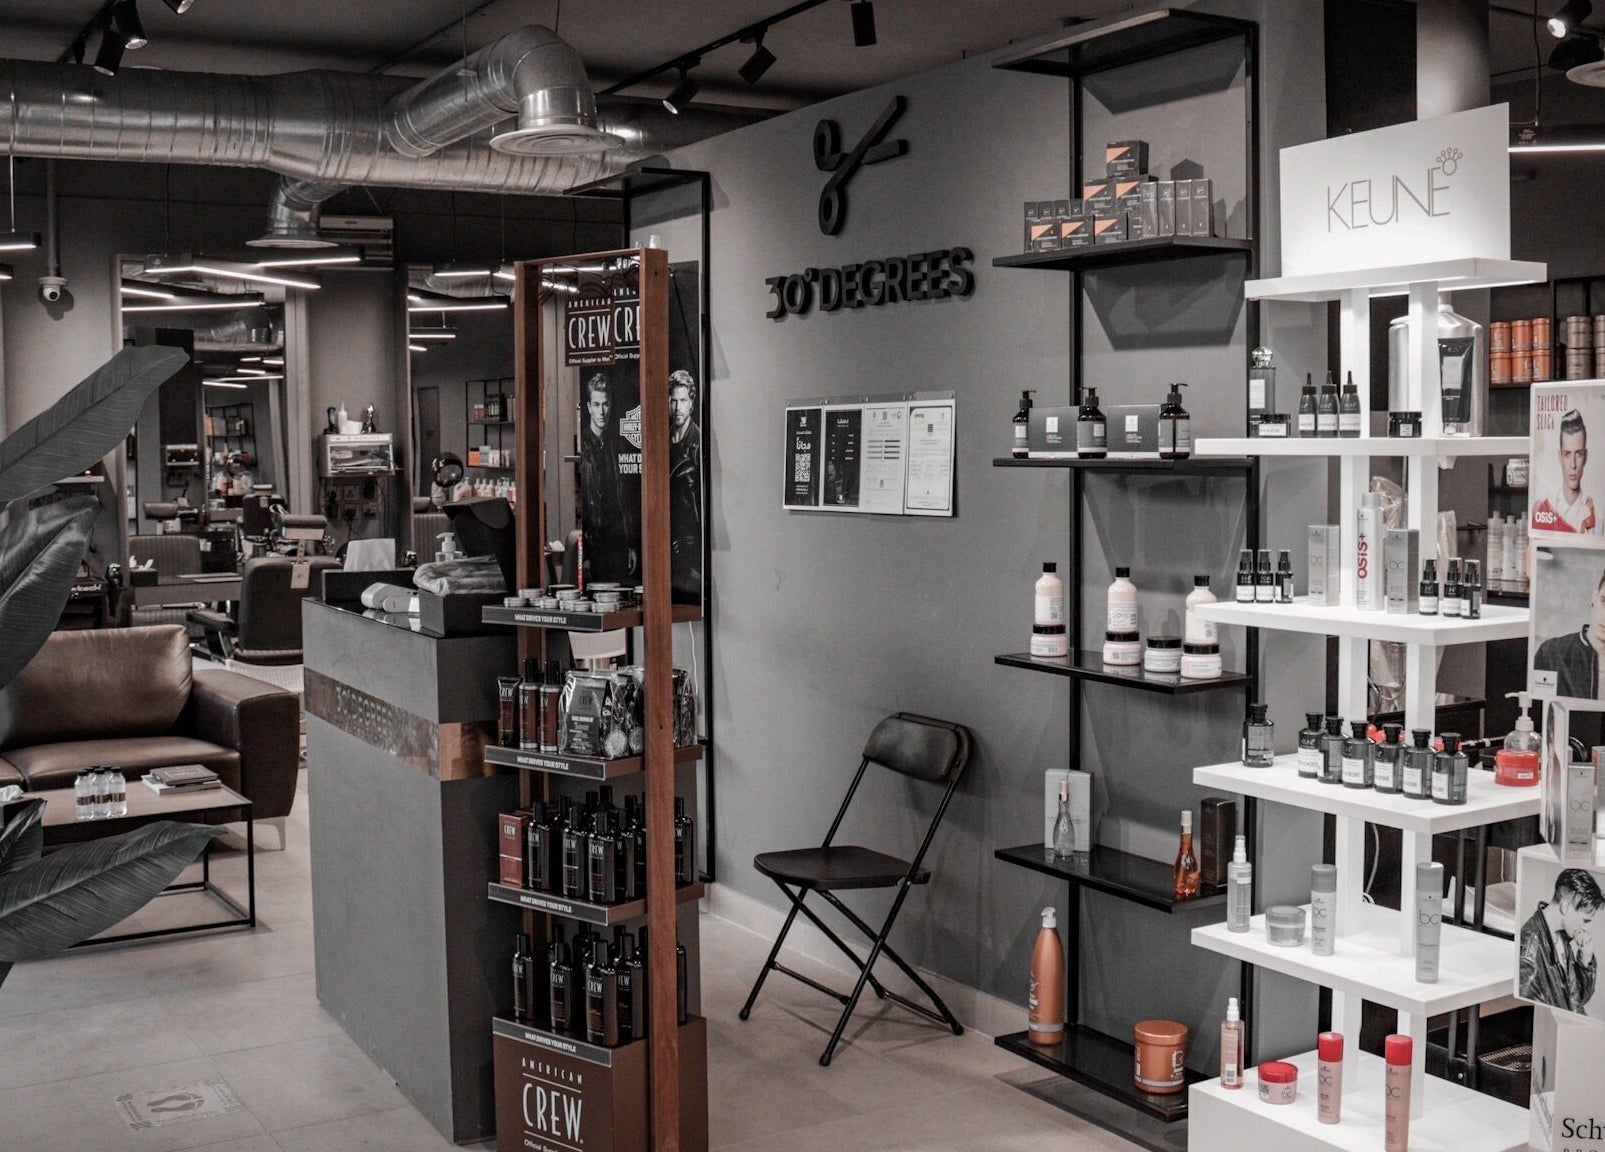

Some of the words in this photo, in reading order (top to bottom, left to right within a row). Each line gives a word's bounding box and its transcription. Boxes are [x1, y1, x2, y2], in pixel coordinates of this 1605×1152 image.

[1327, 166, 1451, 233] KEUNE
[568, 298, 611, 309] AMERICAN
[614, 306, 640, 342] CRE
[618, 453, 637, 463] WHAT
[618, 463, 638, 474] YOUR
[553, 616, 567, 624] STYLE
[555, 761, 569, 770] STYLE
[558, 903, 572, 913] STYLE
[587, 980, 603, 993] CREW
[524, 1032, 536, 1040] WHAT
[552, 1039, 562, 1049] YOUR
[562, 1042, 576, 1053] STYLE
[522, 1057, 583, 1084] AMERICAN
[1561, 1117, 1605, 1140] Sch
